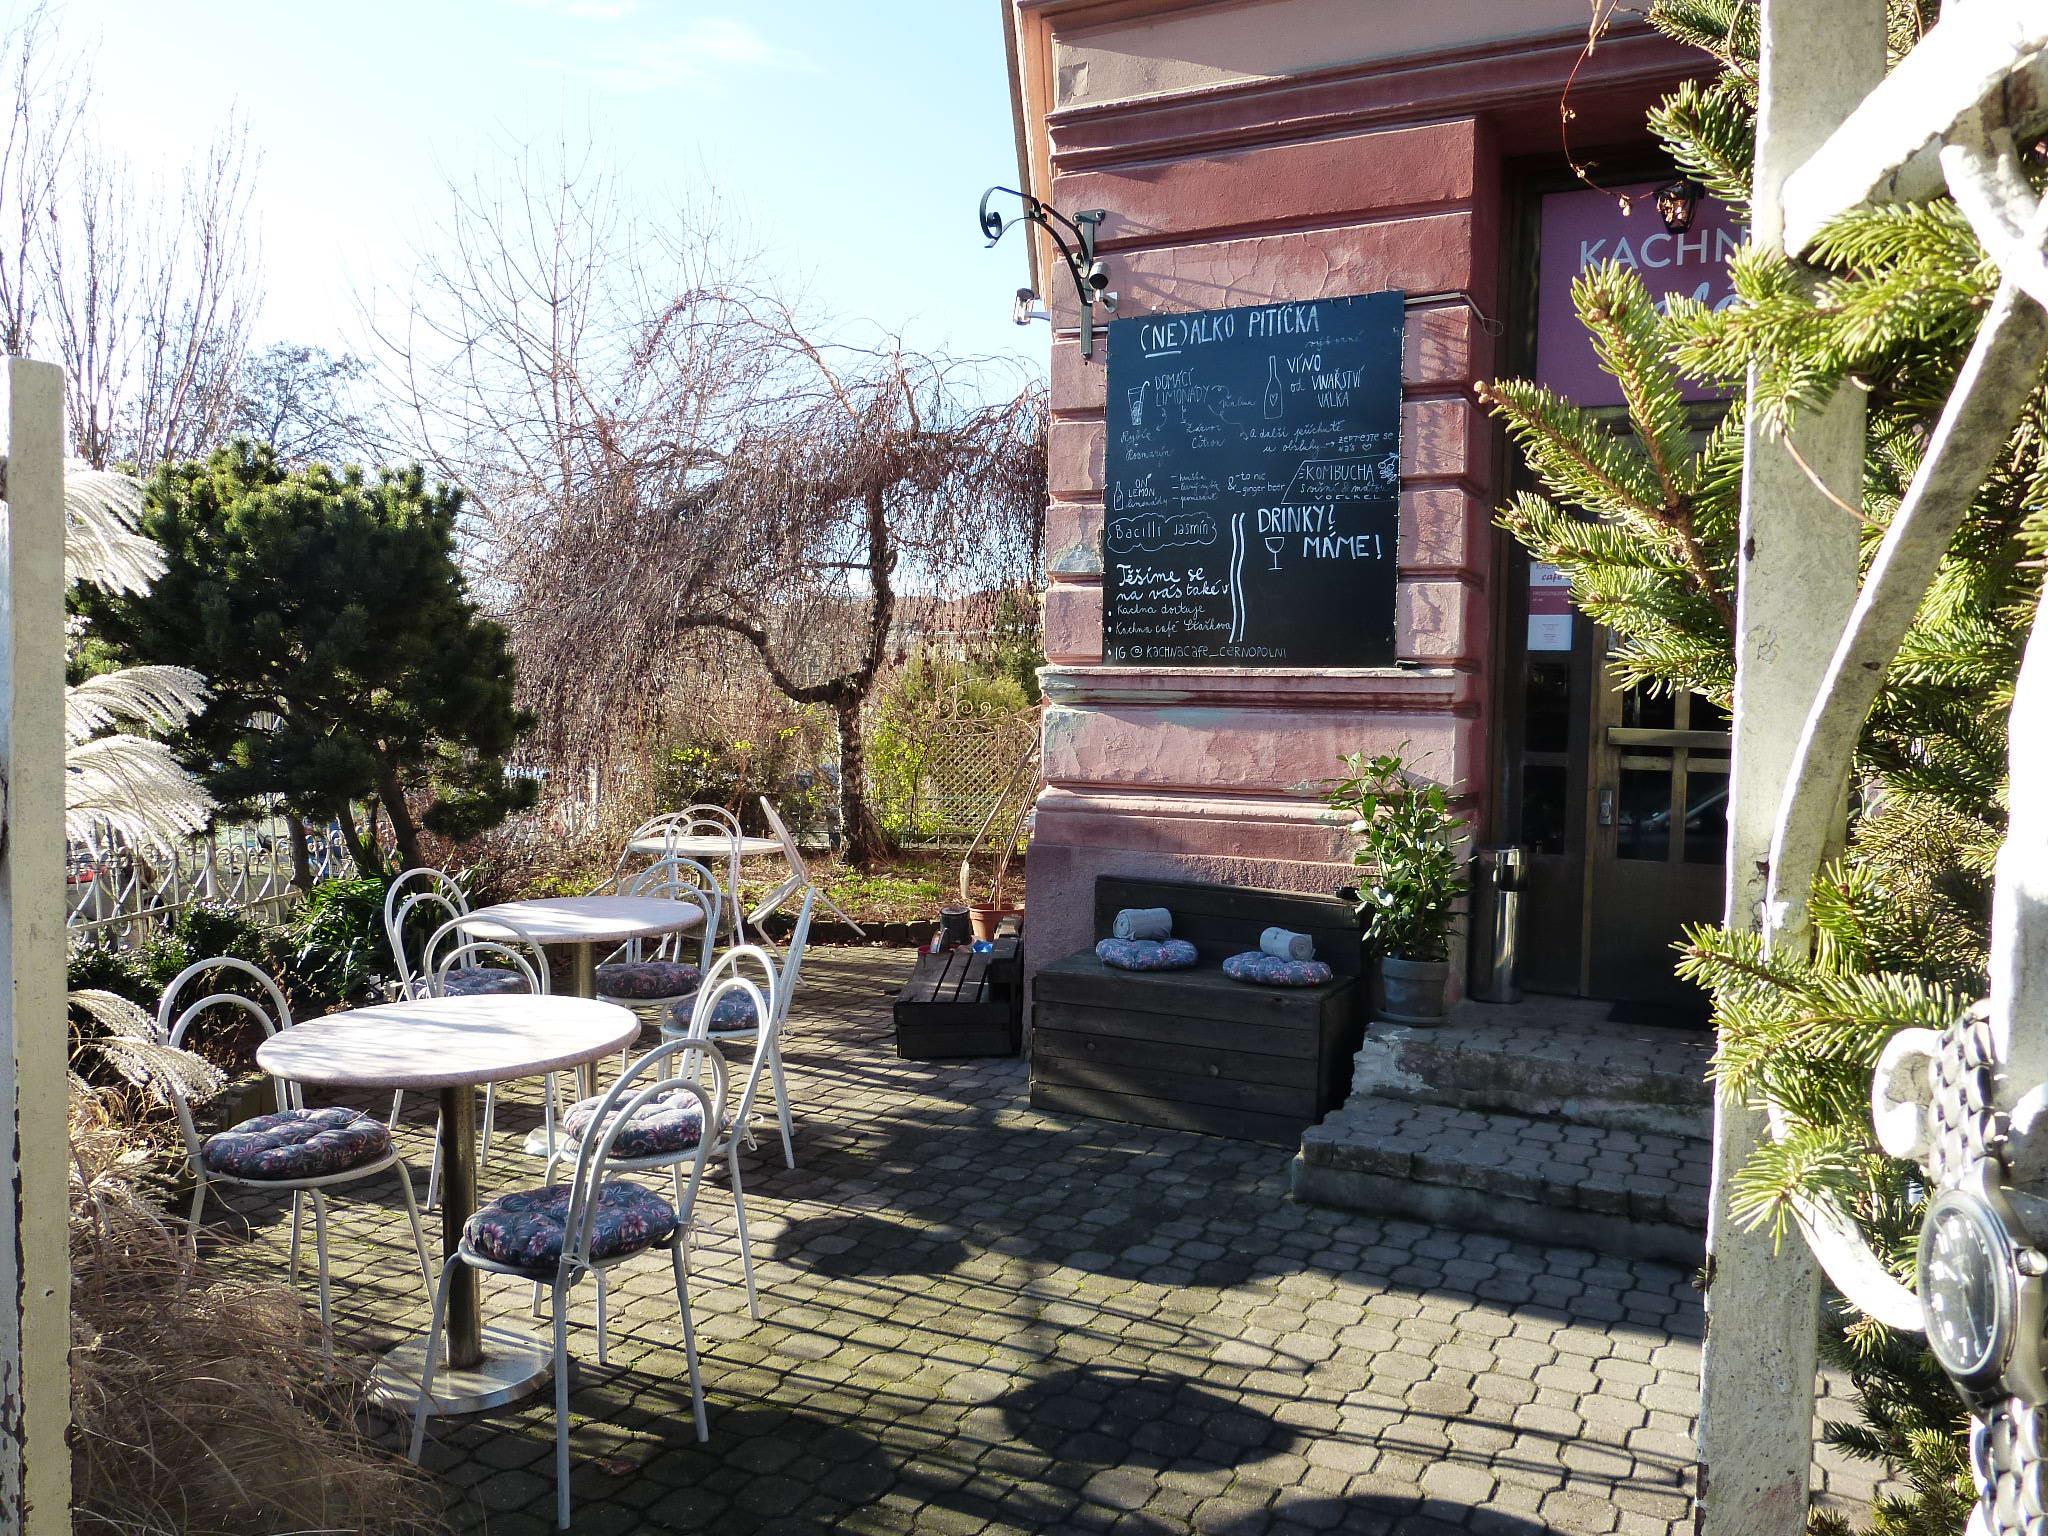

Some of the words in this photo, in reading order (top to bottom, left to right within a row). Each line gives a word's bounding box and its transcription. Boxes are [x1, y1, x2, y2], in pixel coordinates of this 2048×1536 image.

[1579, 226, 1751, 273] KACHN
[1140, 312, 1234, 351] (NE)ALKO
[1248, 303, 1320, 337] PITÍČKA
[1286, 353, 1321, 373] VÍNO
[1154, 367, 1194, 390] DOMÁCÍ
[1312, 365, 1365, 391] VINAŘSTVÍ
[1155, 384, 1210, 407] LIMONÁDY
[1305, 464, 1375, 482] KOMBUCHA
[1128, 488, 1155, 498] LEMON
[1257, 504, 1336, 533] DRINKY?
[1303, 531, 1382, 560] MÁME!
[1117, 564, 1181, 586] Těšíme
[1187, 567, 1205, 581] se
[1116, 590, 1144, 601] na
[1149, 584, 1183, 600] vás
[1186, 579, 1221, 596] také
[1115, 647, 1126, 660] IG
